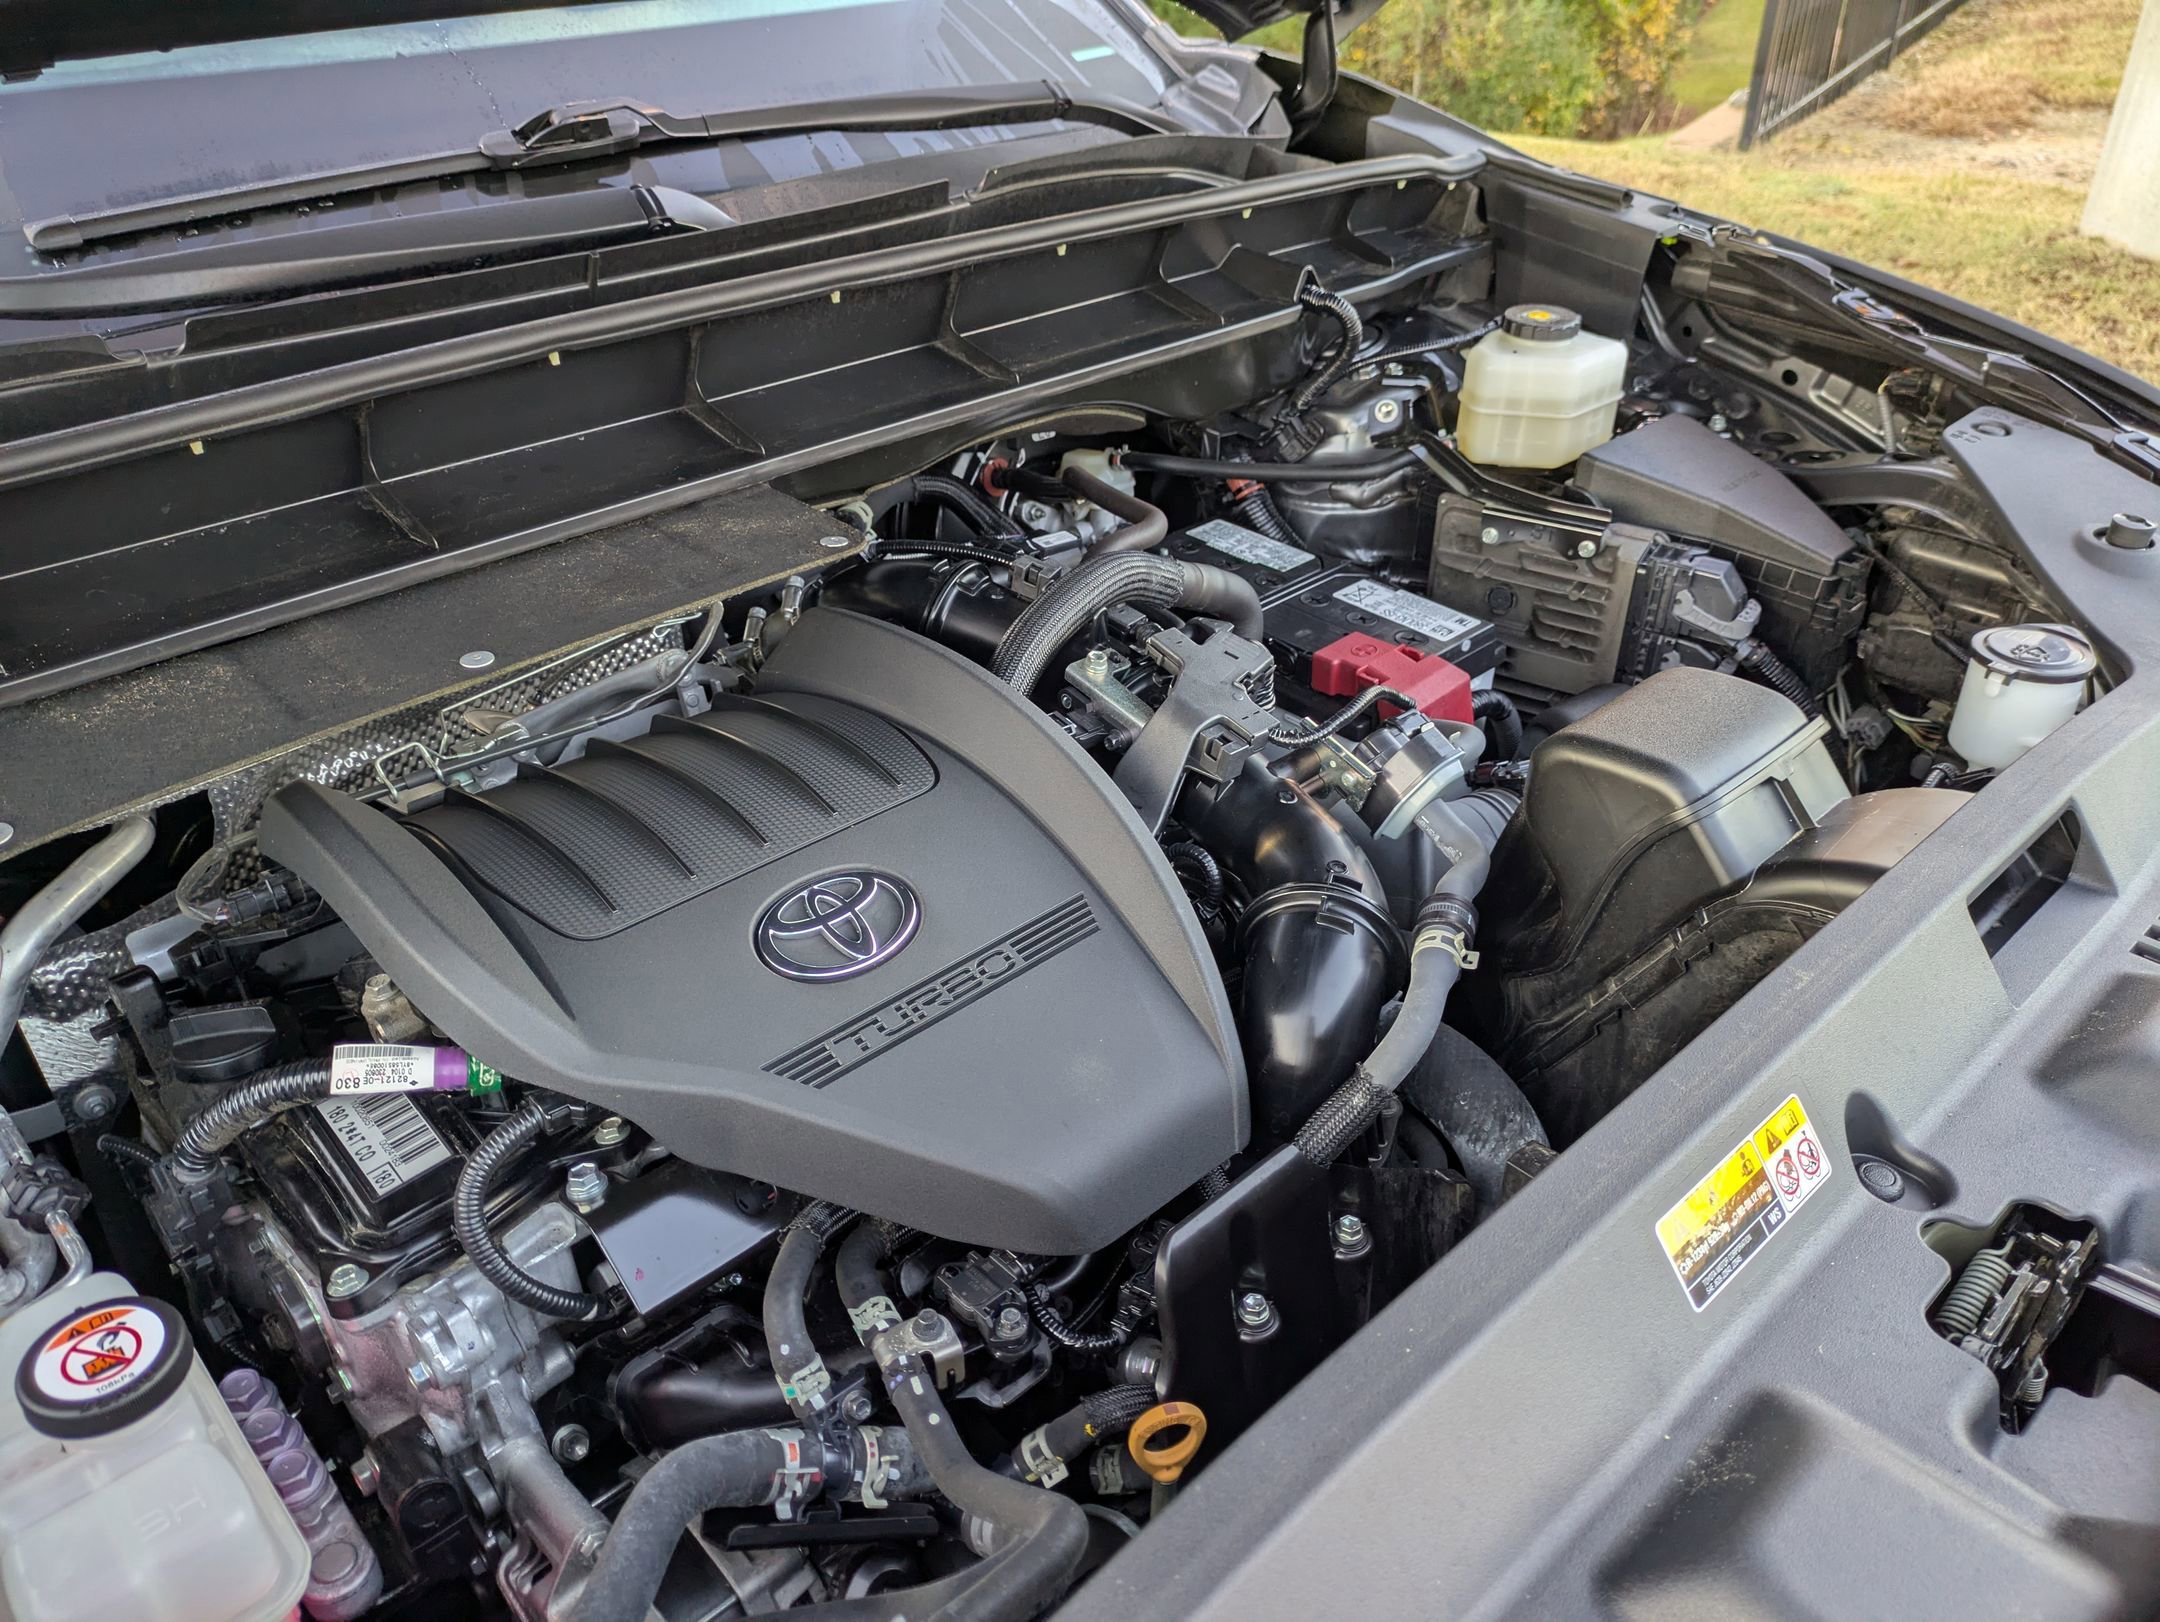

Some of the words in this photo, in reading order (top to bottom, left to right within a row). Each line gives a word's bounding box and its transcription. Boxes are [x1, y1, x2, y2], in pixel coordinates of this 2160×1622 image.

[831, 948, 1016, 1053] TURBO
[327, 1106, 349, 1124] 180
[373, 1170, 395, 1189] 180
[1767, 1207, 1782, 1225] WS
[96, 1371, 135, 1394] 108kPa
